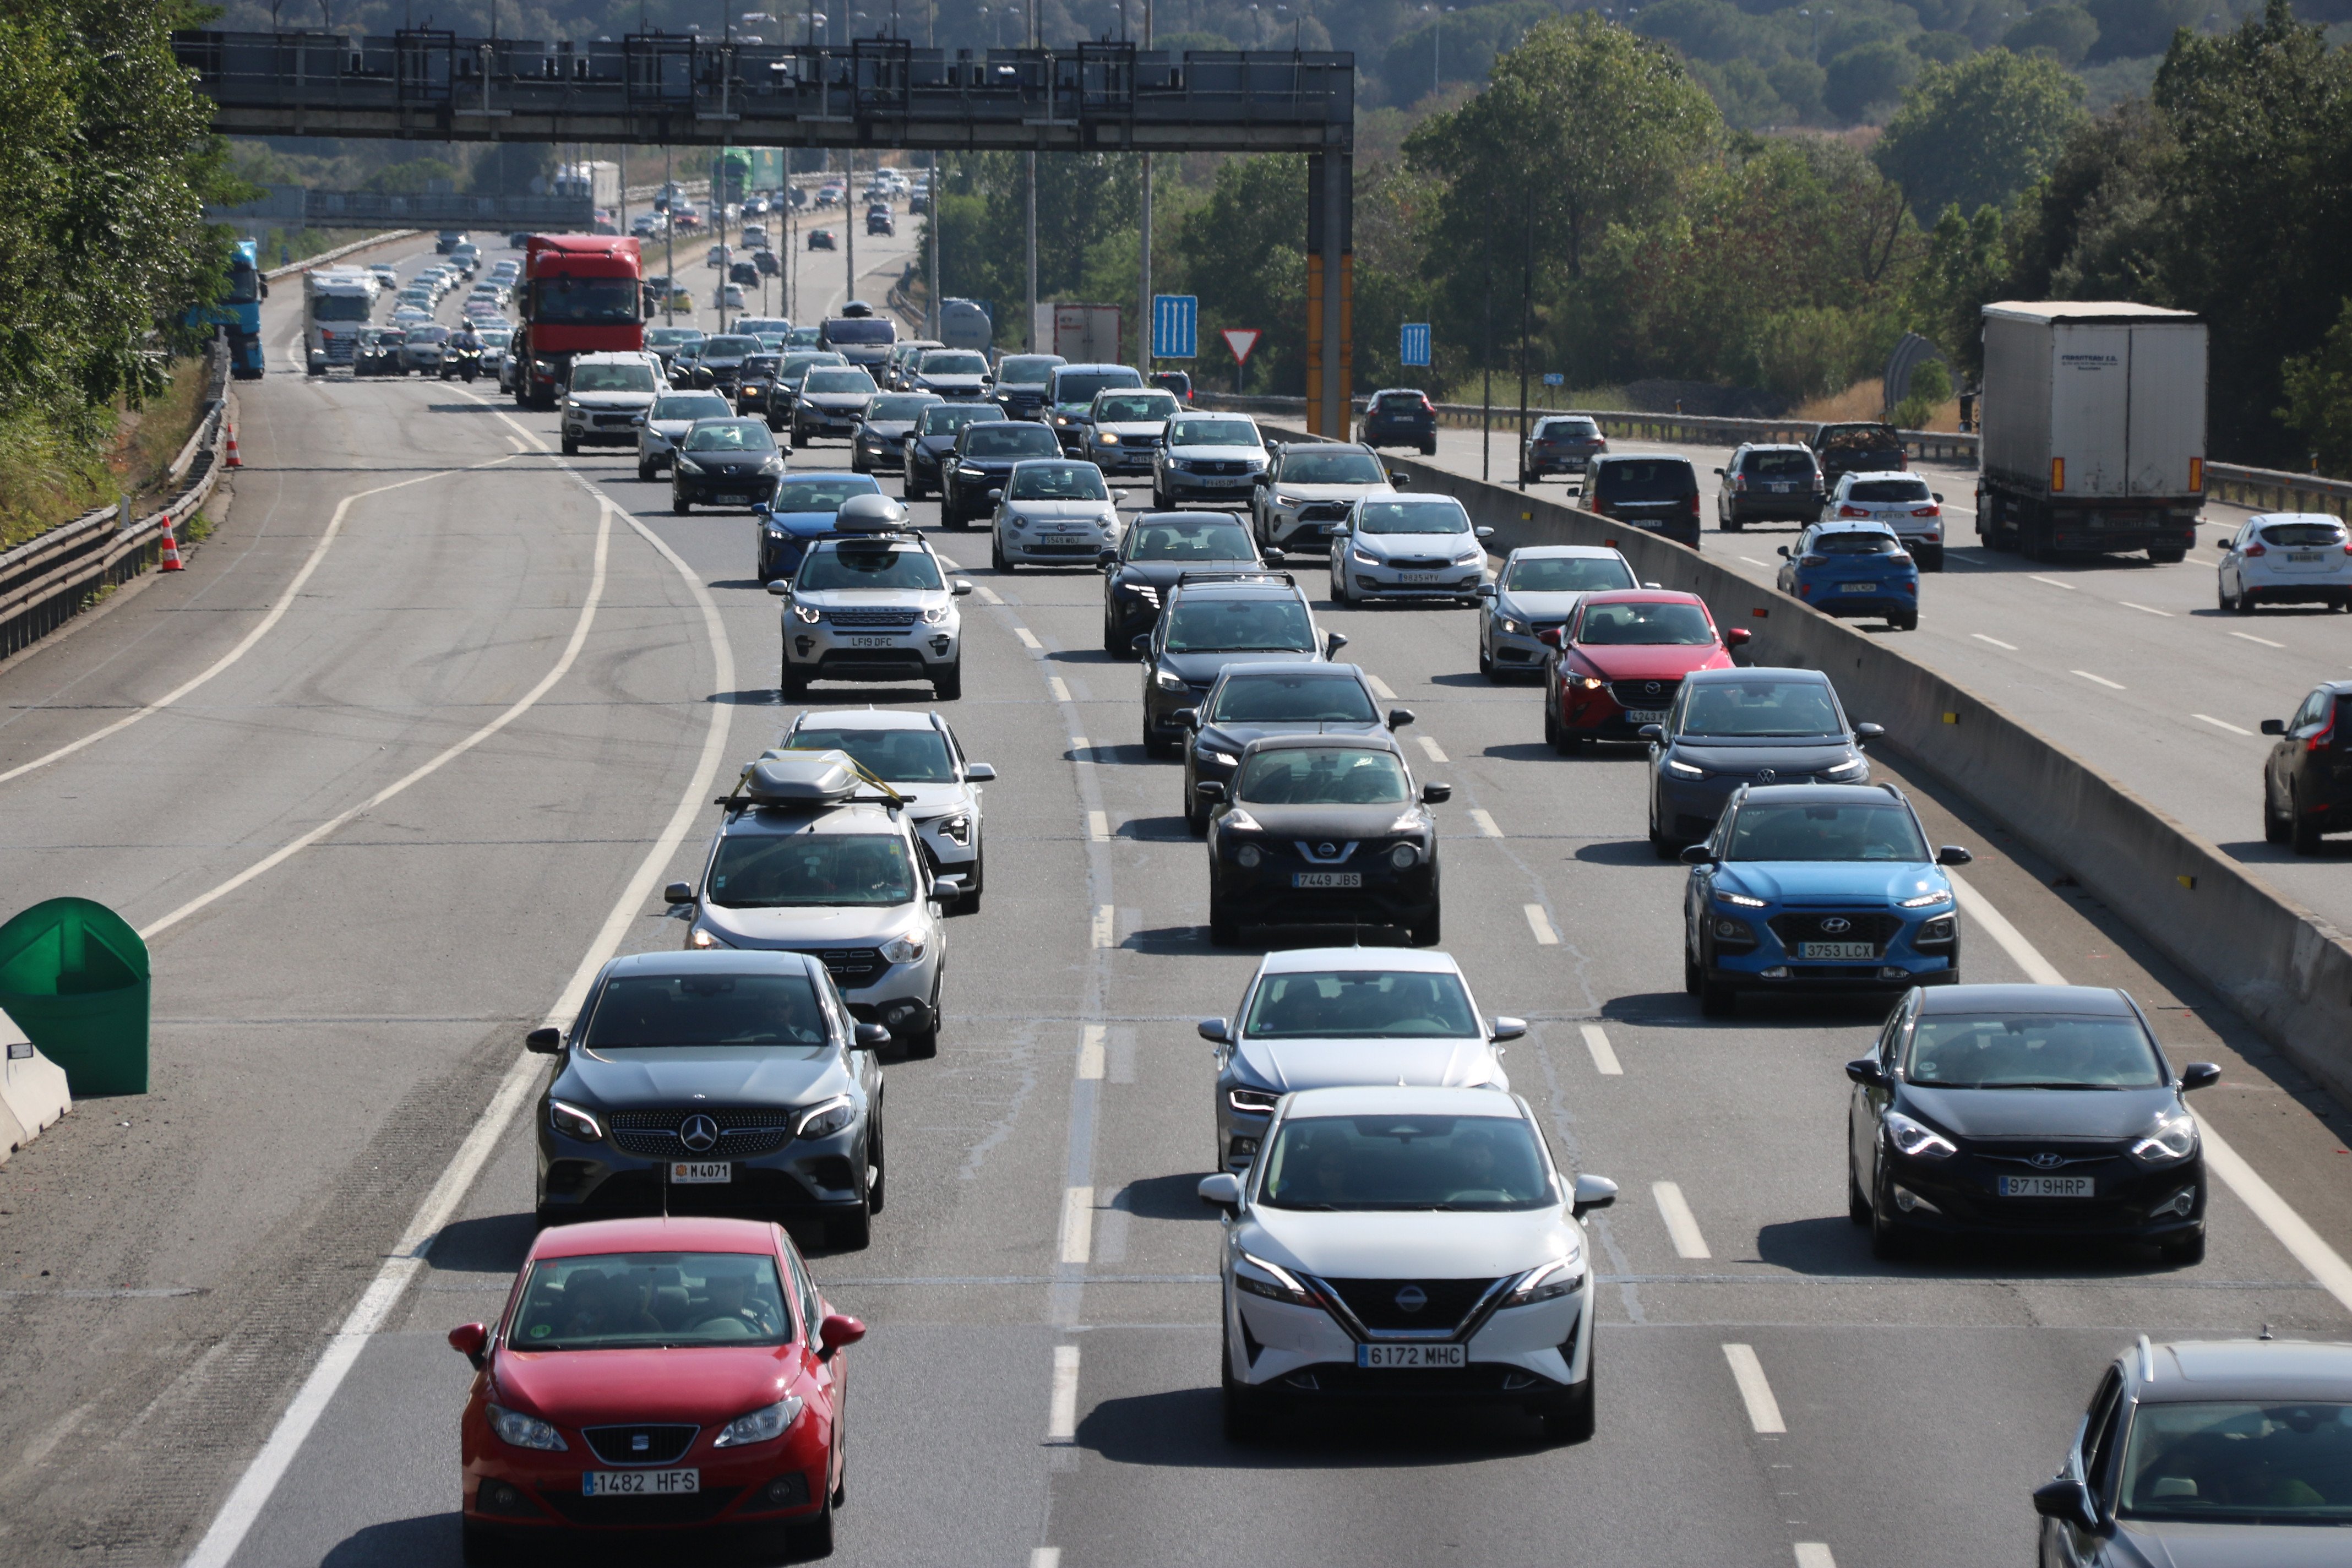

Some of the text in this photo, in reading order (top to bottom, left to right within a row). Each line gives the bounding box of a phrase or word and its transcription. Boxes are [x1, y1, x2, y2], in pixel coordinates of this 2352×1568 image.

[852, 638, 892, 646] LF19 DFC
[1632, 711, 1656, 721] 4243
[1301, 874, 1358, 885] 7449 JBS
[1808, 945, 1870, 957] 3753 LCX
[690, 1164, 727, 1177] M 4071
[1371, 1347, 1460, 1365] 6172 MHC
[599, 1472, 695, 1493] 1482 HFS
